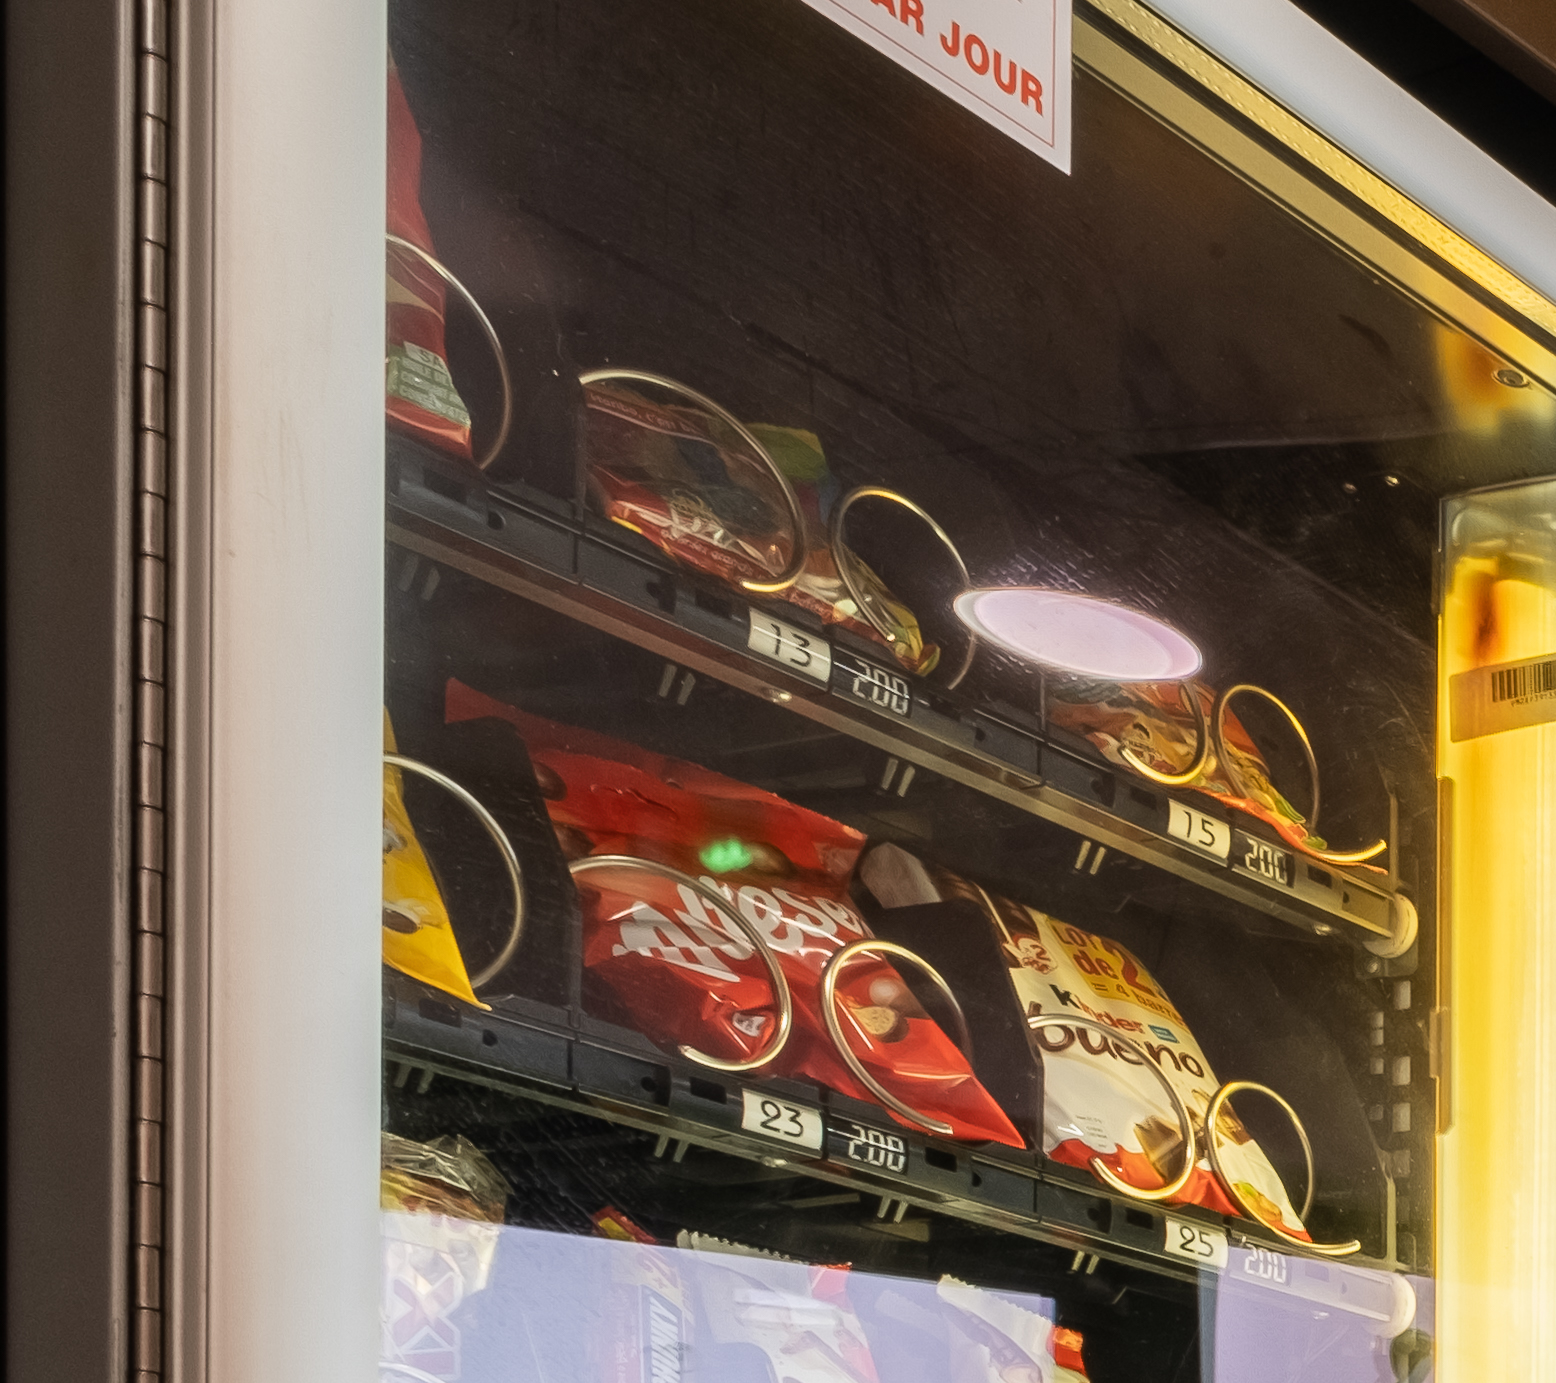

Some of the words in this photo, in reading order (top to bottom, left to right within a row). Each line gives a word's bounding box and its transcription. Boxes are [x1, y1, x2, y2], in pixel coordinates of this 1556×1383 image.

[939, 20, 1044, 118] JOUR
[769, 623, 813, 668] 13
[852, 658, 910, 716] 200
[1182, 811, 1217, 849] 15
[1243, 836, 1289, 885] 200
[1027, 1000, 1205, 1079] bueno
[759, 1099, 806, 1139] 23
[847, 1125, 907, 1171] 200
[1178, 1225, 1214, 1259] 25
[1243, 1246, 1288, 1283] 200
